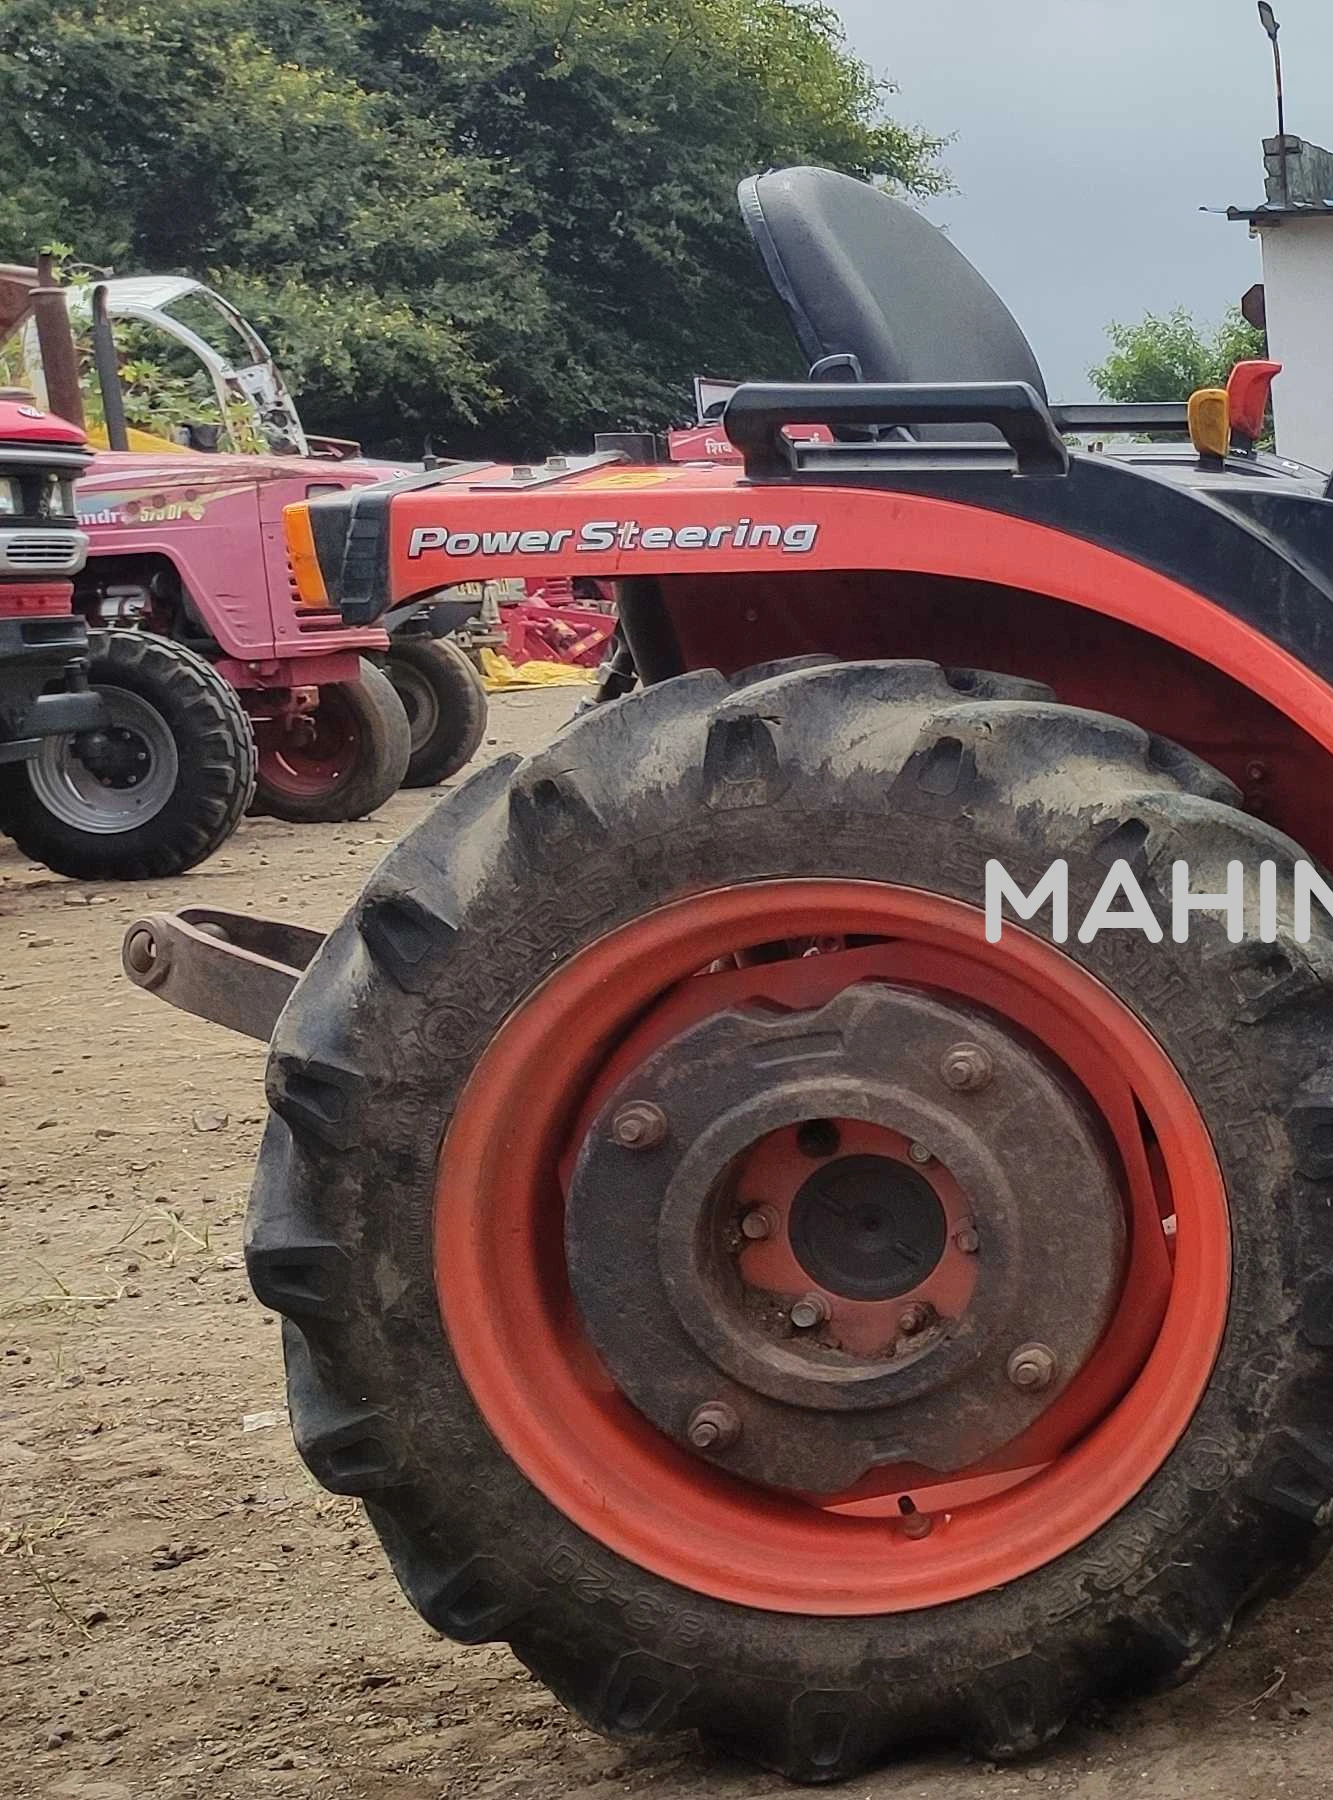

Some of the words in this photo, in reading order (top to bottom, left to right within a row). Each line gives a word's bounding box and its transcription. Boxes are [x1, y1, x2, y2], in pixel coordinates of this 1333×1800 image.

[408, 527, 573, 557] Power
[575, 519, 820, 554] Steering
[541, 1542, 707, 1650] 8.3-20
